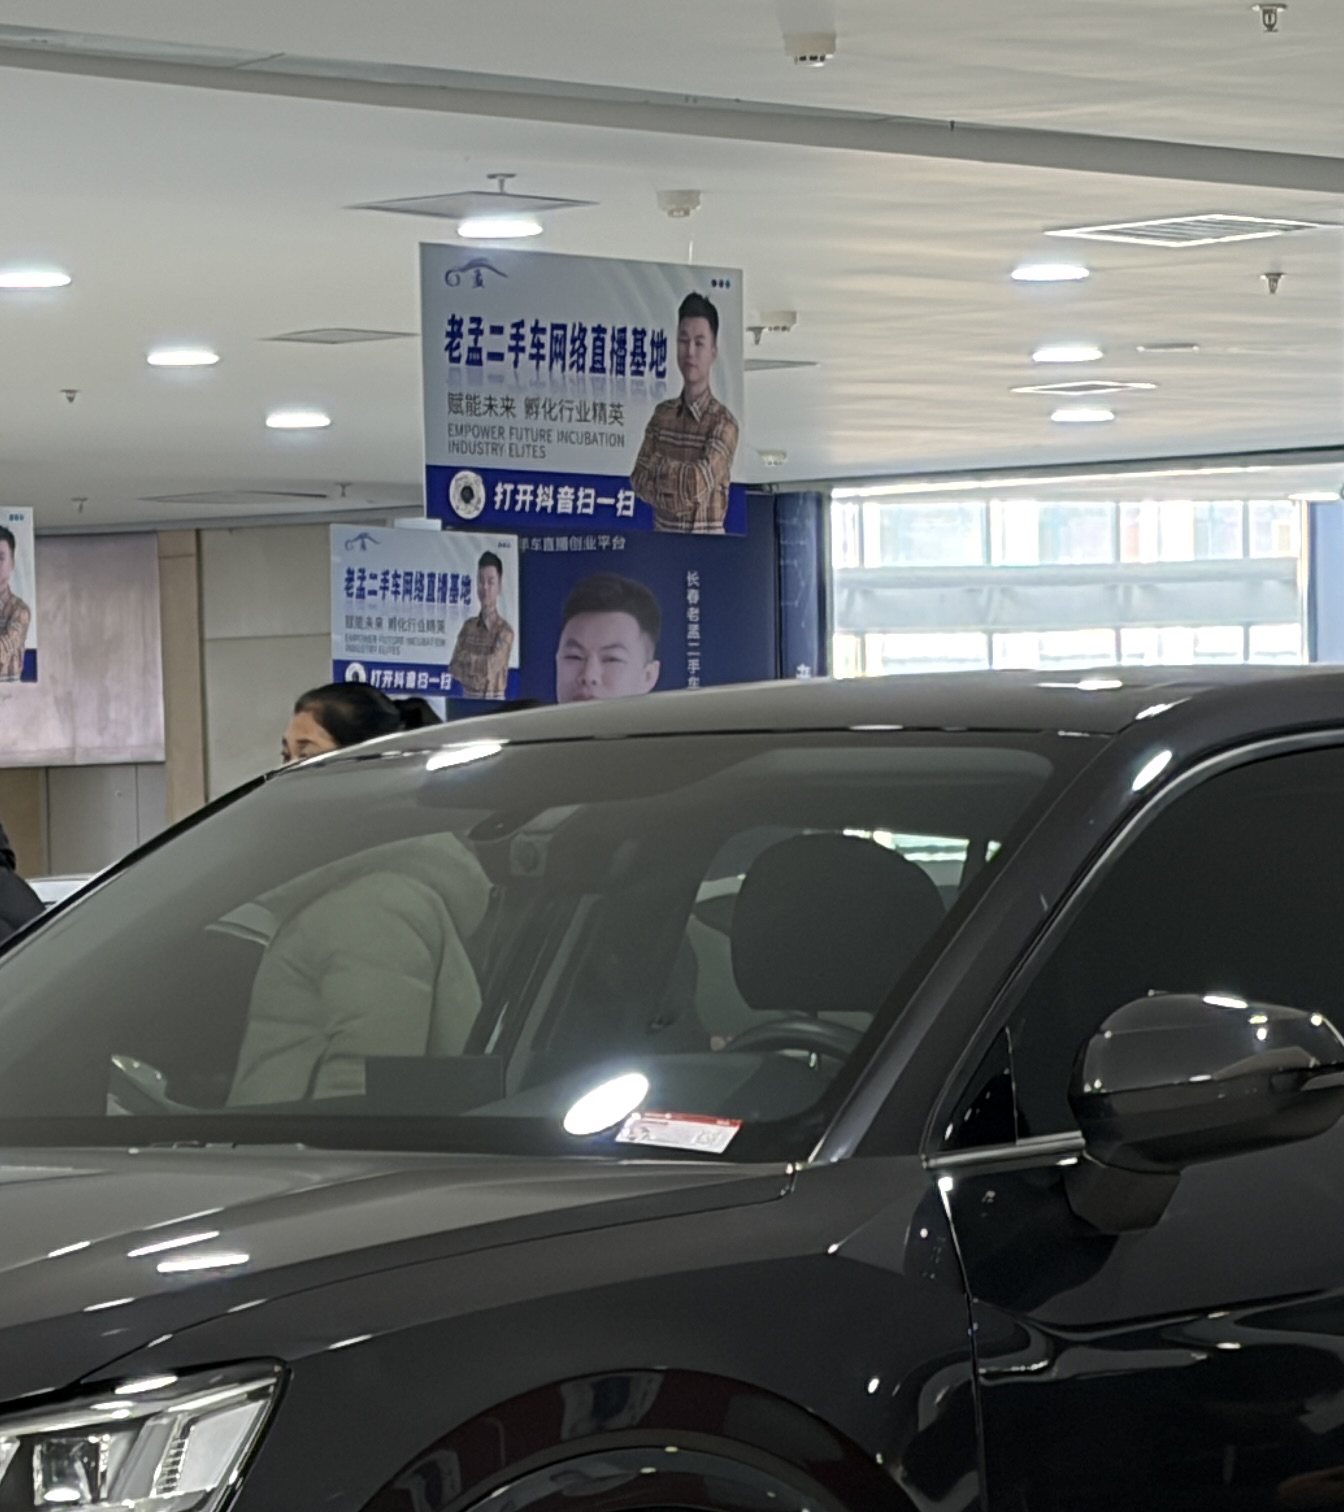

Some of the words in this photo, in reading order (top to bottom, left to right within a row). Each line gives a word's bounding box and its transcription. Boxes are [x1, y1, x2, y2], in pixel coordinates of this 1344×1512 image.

[444, 313, 667, 379] 老孟二手车网络直播基地
[447, 392, 516, 419] 赋能未来
[525, 397, 624, 427] 孵化行业精英
[447, 423, 505, 441] EMPOWER
[509, 426, 553, 443] FUTURE
[557, 429, 624, 447] INCUBATION
[447, 440, 504, 457] INDUSTRY
[508, 444, 546, 459] ELITES
[494, 481, 635, 517] 打开抖音扫一扫
[345, 567, 471, 606] 老孟二手车网络直播基地
[371, 669, 452, 690] 打开抖音扫一扫
